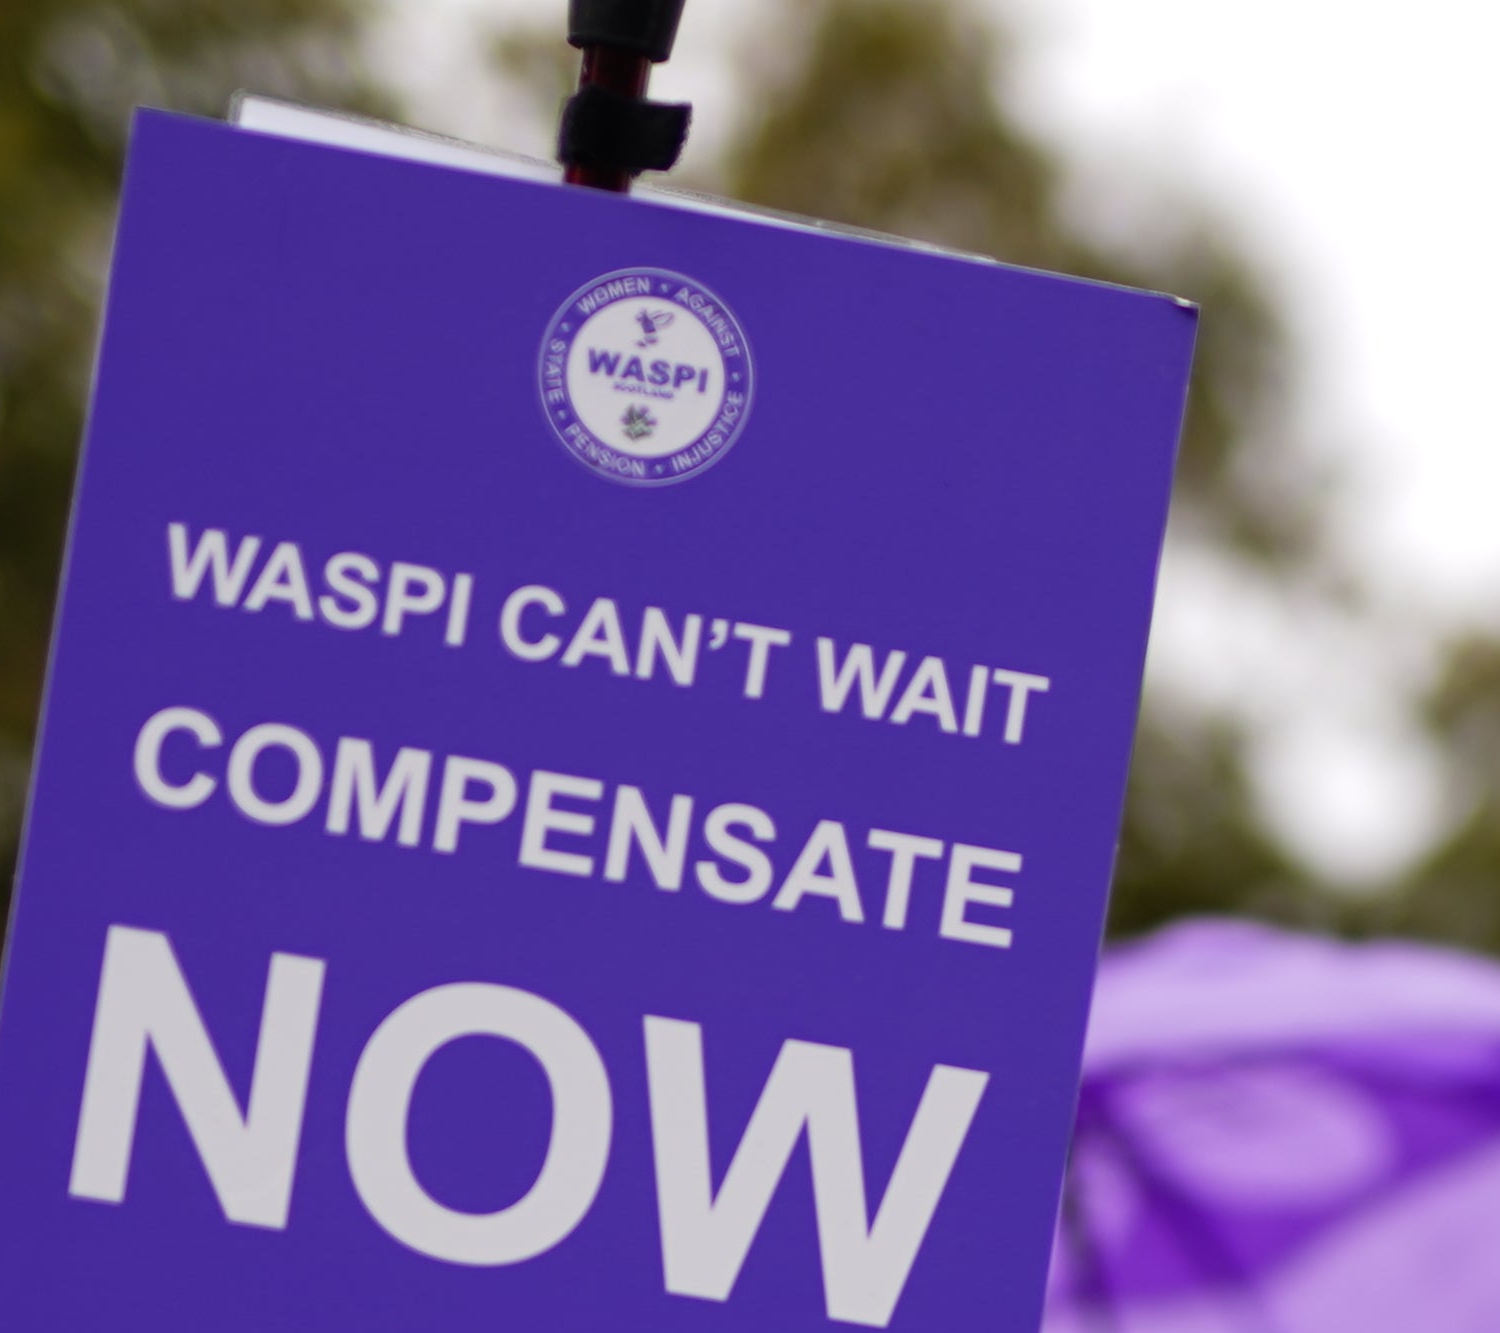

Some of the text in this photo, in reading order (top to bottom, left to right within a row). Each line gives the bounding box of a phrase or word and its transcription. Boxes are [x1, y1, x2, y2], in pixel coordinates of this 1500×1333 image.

[576, 277, 741, 358] WOMEN AGAINST
[587, 346, 709, 394] WASPI
[167, 521, 1050, 746] WASPI CAN'T WAIT
[132, 706, 1023, 948] COMPENSATE
[69, 923, 990, 1328] NOW
